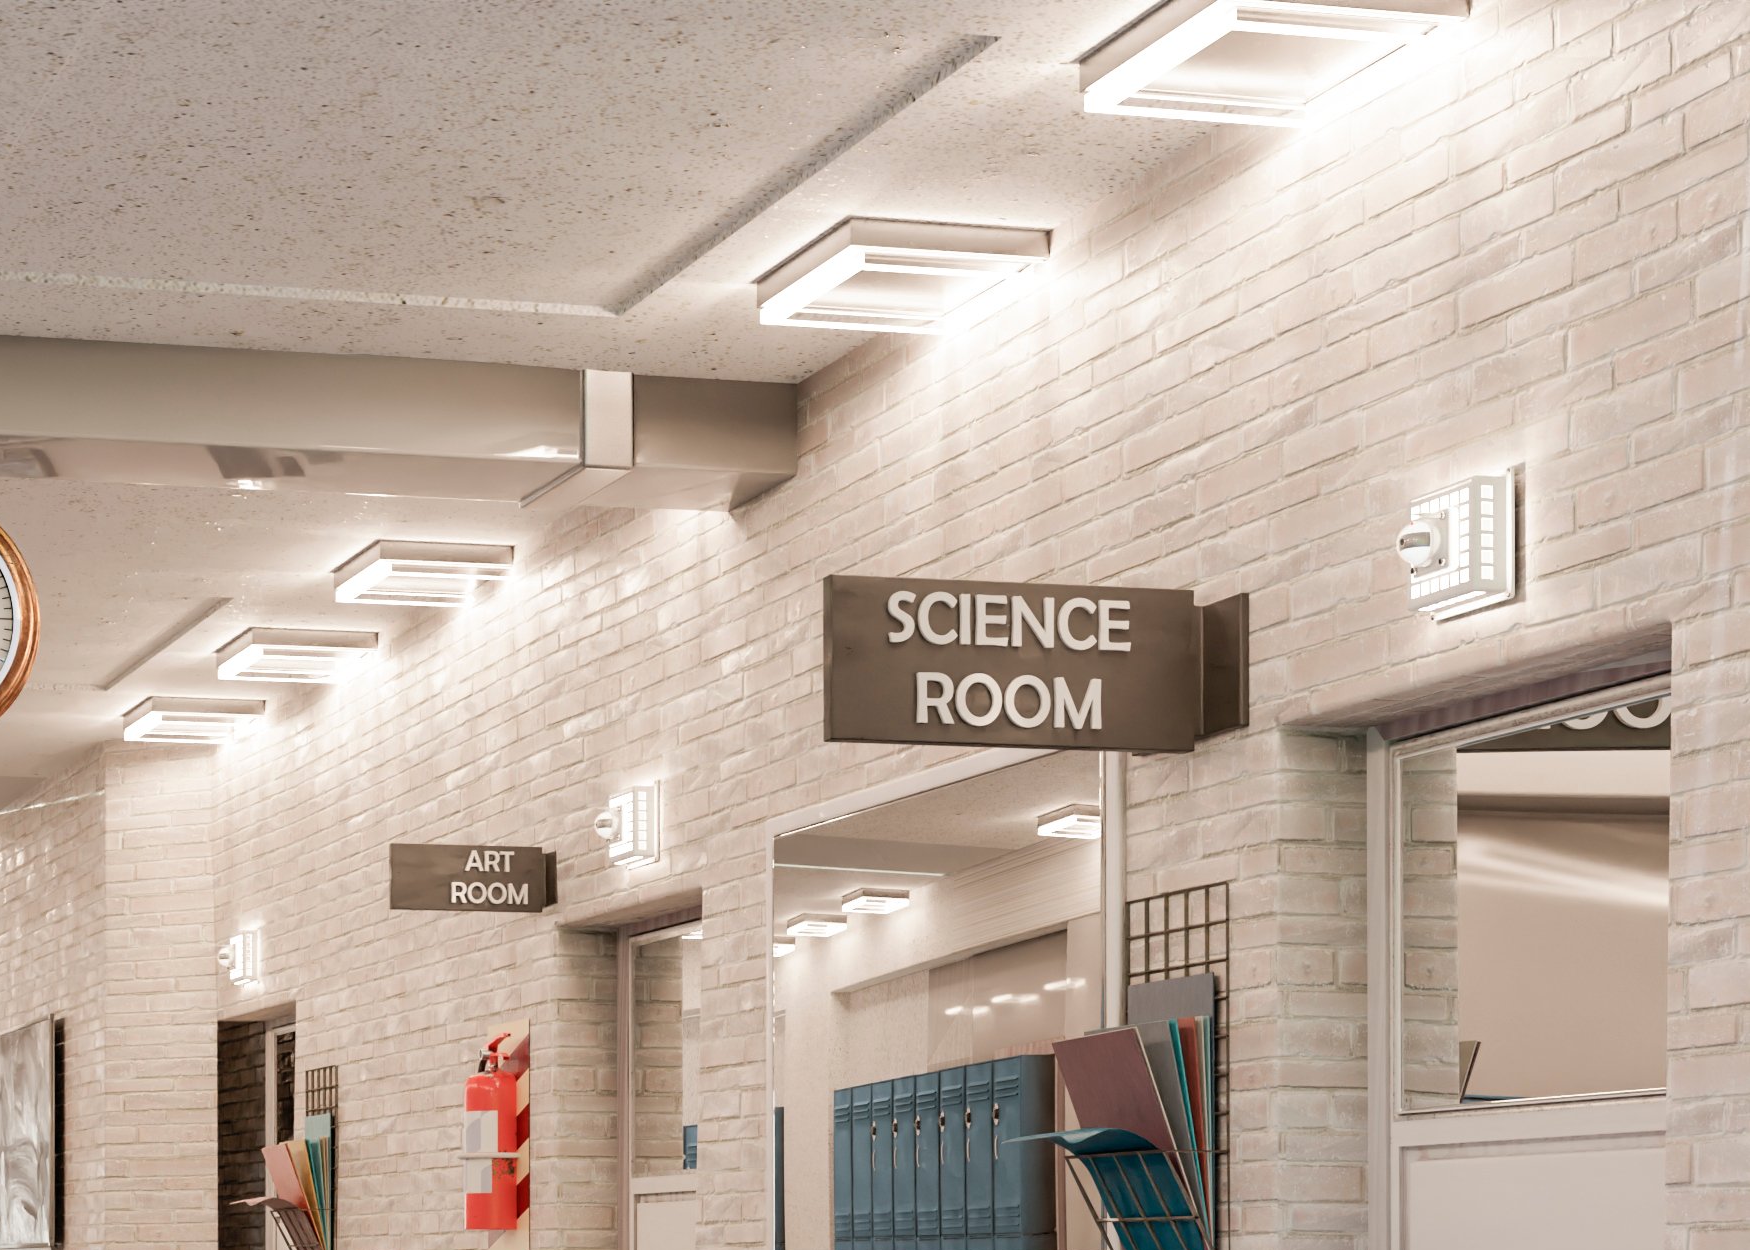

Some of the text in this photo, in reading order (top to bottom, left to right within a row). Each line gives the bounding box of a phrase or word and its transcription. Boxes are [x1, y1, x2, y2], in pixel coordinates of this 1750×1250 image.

[887, 590, 1132, 652] SCIENCE
[915, 671, 1103, 730] ROOM
[464, 849, 515, 873] ART
[450, 881, 529, 905] ROOM
